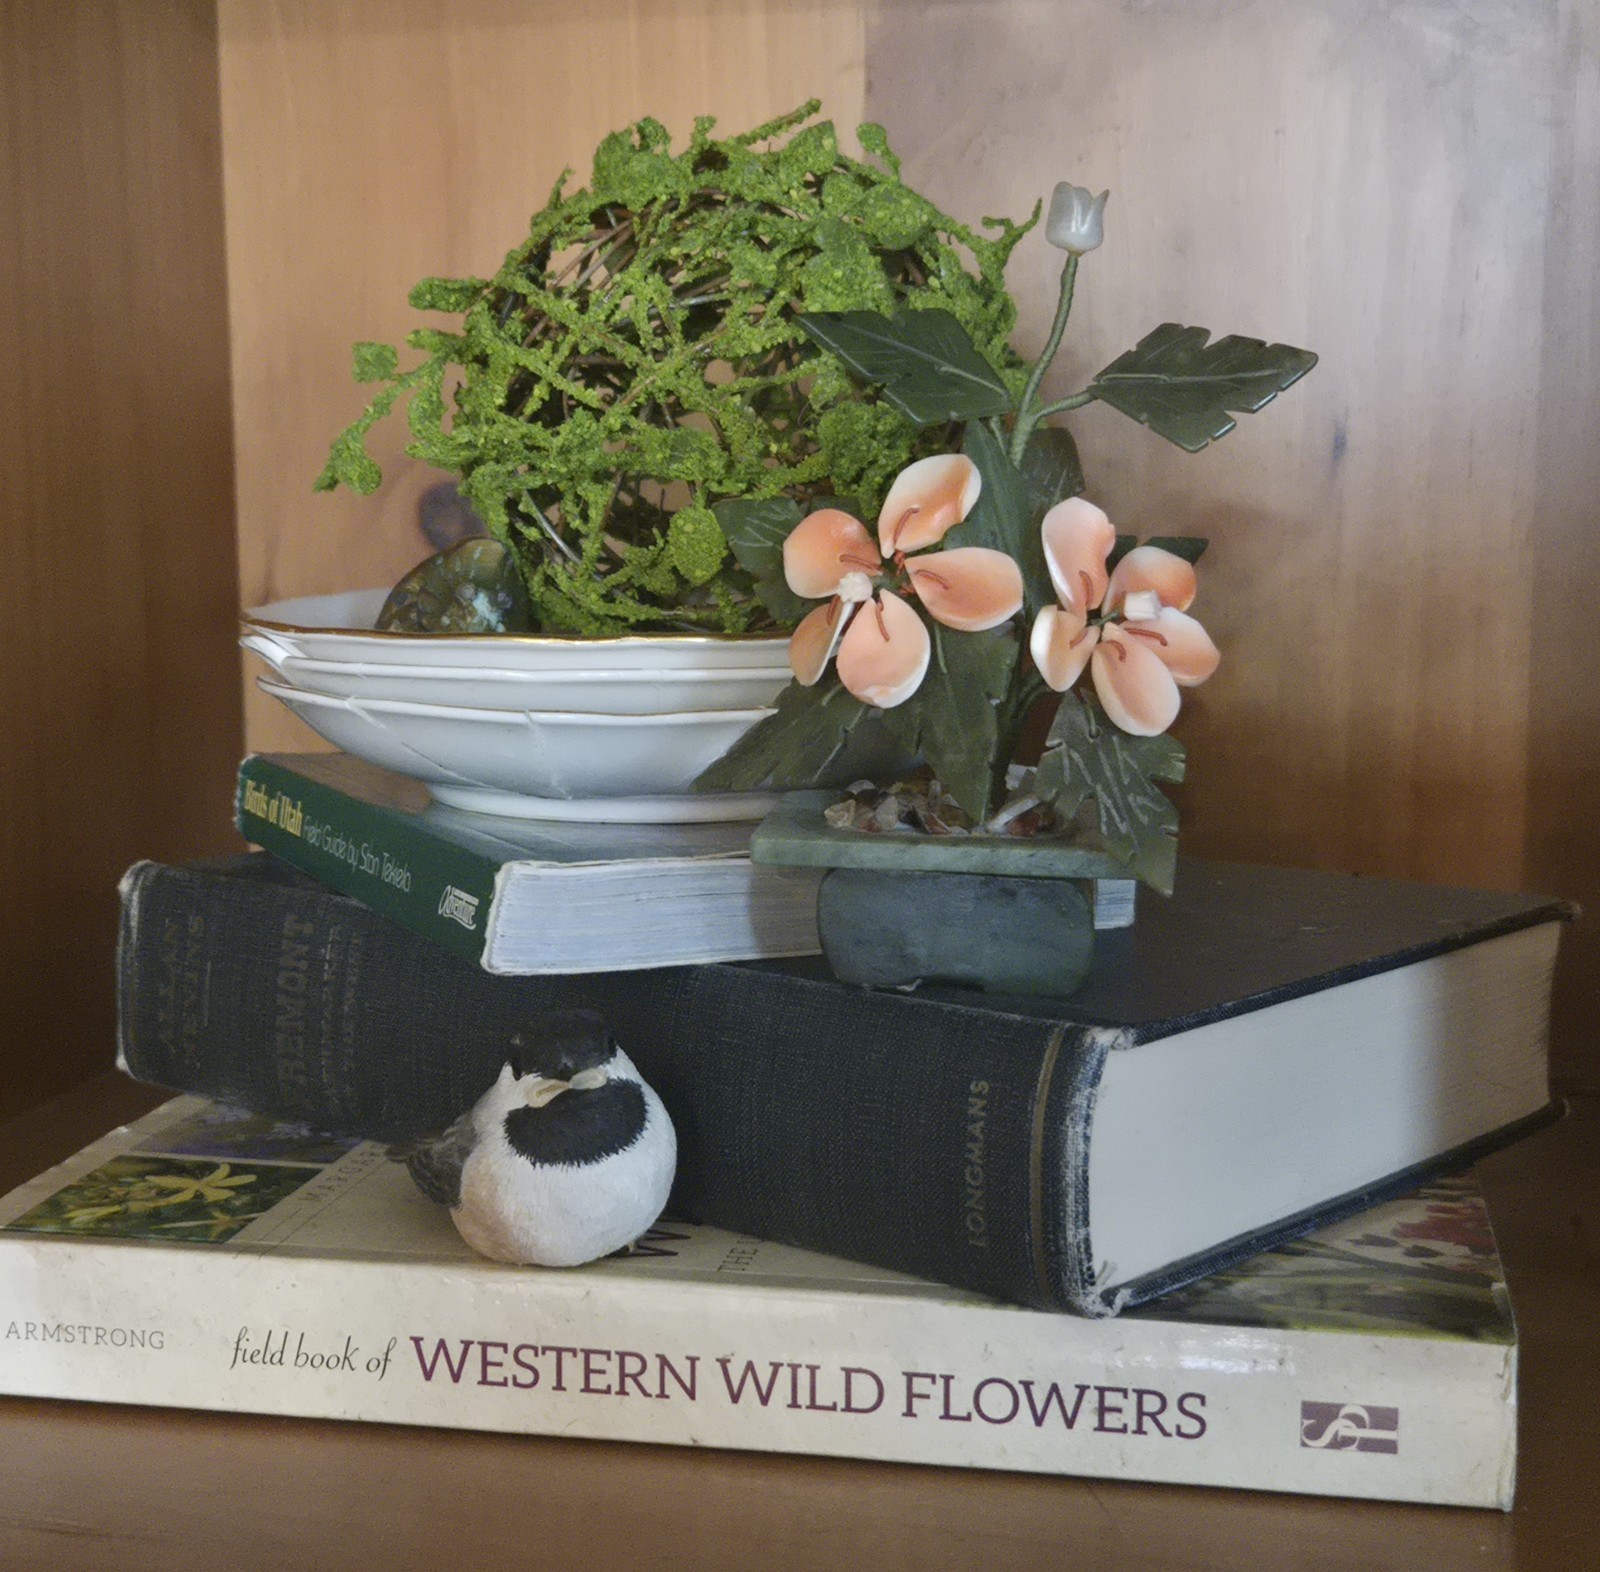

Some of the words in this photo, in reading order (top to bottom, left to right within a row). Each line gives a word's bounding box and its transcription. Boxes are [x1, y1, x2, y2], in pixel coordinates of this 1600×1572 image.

[243, 779, 268, 819] Birds
[268, 791, 281, 825] of
[279, 795, 303, 838] Utah
[303, 815, 322, 847] Field
[322, 824, 347, 860] Guide
[347, 837, 360, 873] by
[359, 842, 380, 877] Stan
[965, 1079, 990, 1248] LONGMANS
[5, 1320, 166, 1351] ARMSTRONG
[229, 1325, 286, 1371] field
[294, 1330, 358, 1373] book
[365, 1336, 398, 1382] of
[409, 1335, 701, 1401] WESTERN
[716, 1357, 885, 1415] WILD
[901, 1370, 1209, 1442] FLOWERS
